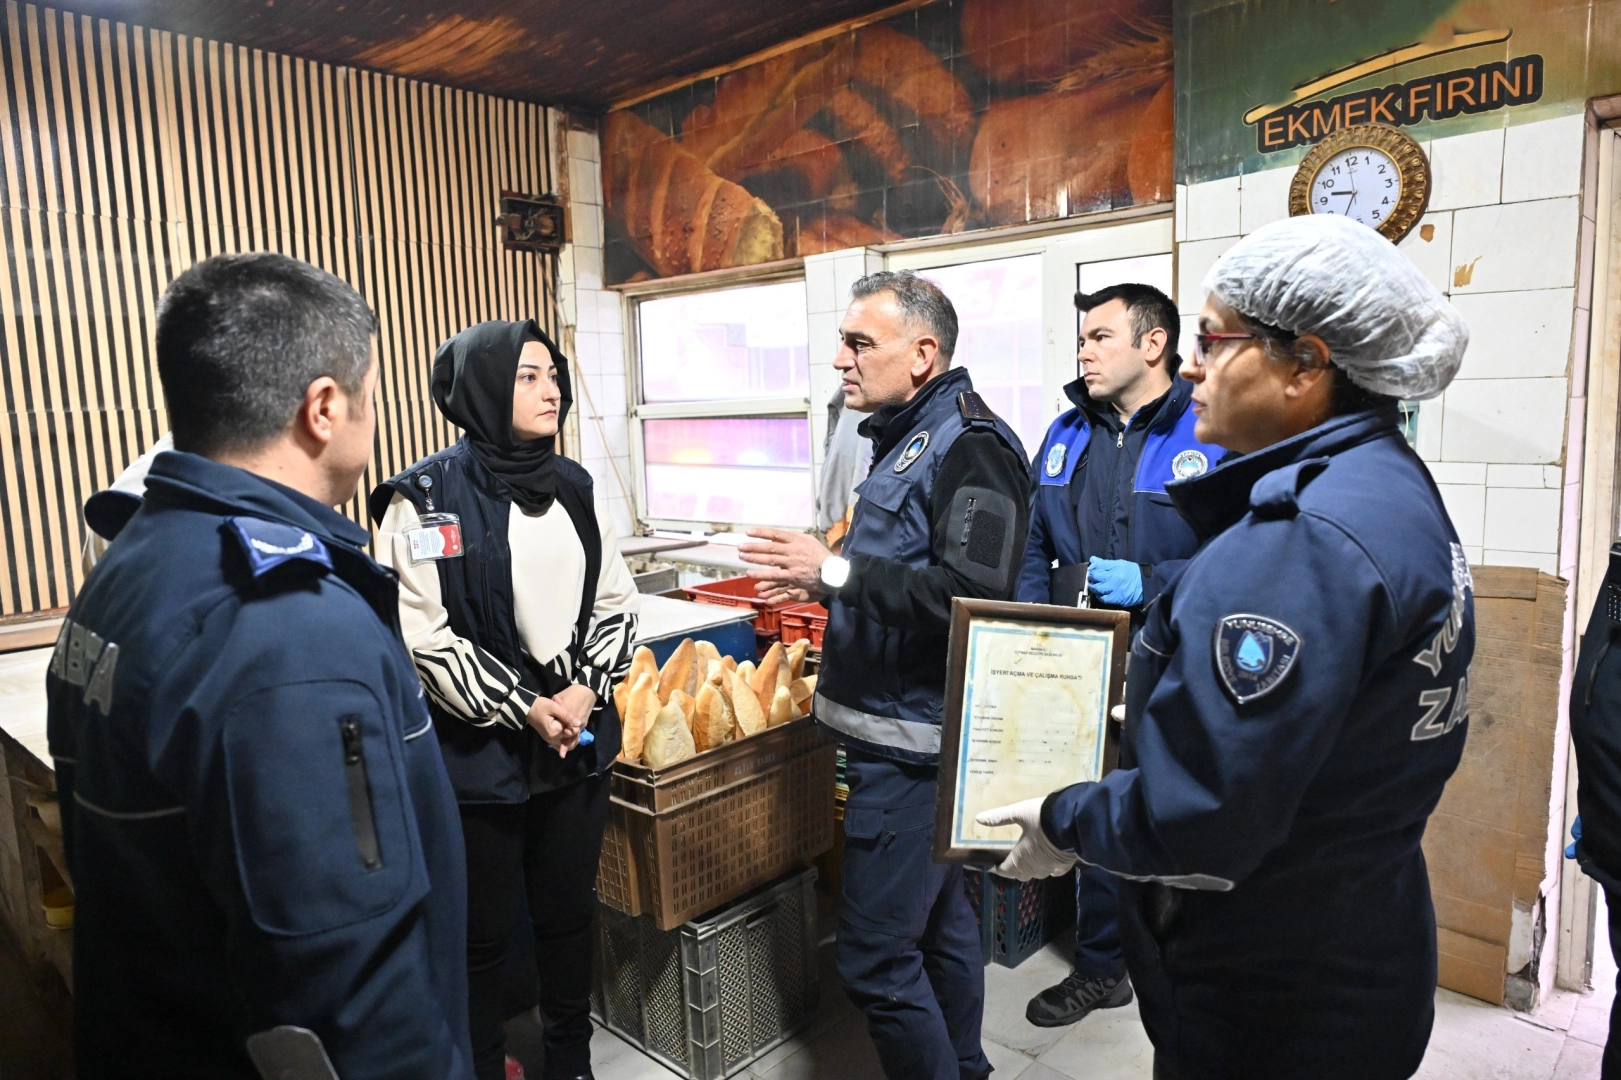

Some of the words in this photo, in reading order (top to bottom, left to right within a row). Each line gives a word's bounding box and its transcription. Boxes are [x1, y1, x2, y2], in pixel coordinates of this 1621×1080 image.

[1264, 91, 1396, 147] EKMEK
[1409, 63, 1534, 118] FIRINI
[1345, 155, 1359, 168] 12
[1364, 155, 1370, 165] 1
[1331, 165, 1341, 176] 11
[1377, 164, 1386, 175] 2
[1321, 178, 1335, 189] 10
[1384, 178, 1393, 188] 3
[1319, 196, 1328, 206] 9
[1381, 195, 1389, 205] 4
[1371, 209, 1380, 219] 5
[1009, 670, 1026, 678] AÇMA
